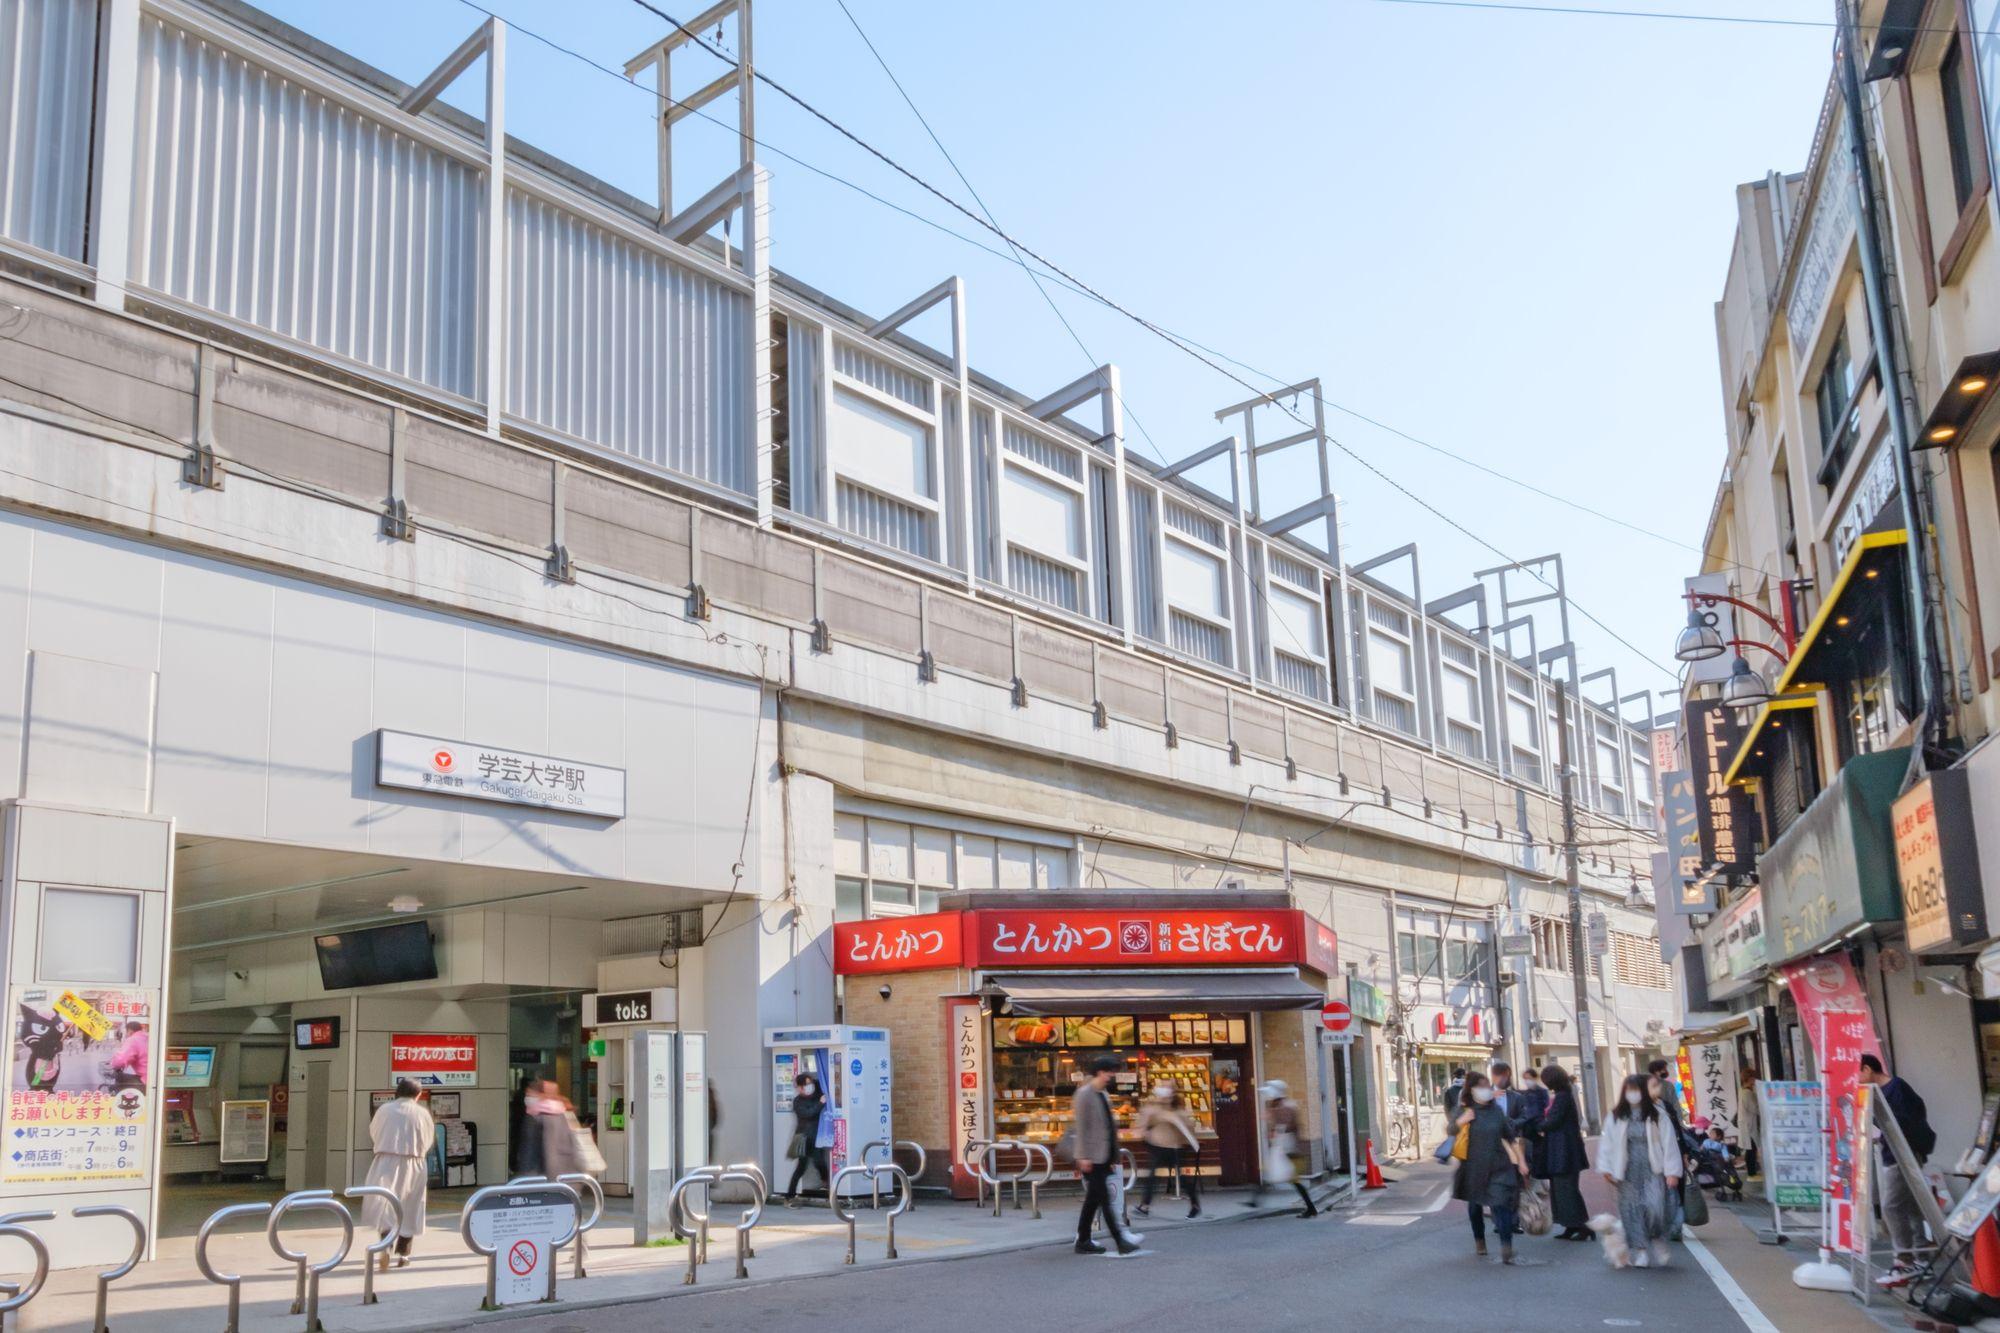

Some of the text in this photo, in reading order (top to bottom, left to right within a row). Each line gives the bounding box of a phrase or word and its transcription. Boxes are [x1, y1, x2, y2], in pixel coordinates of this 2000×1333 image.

[422, 772, 463, 788] 東急電鉄
[478, 753, 585, 792] 学芸大学駅
[480, 781, 564, 803] Gakugei-daigaku
[850, 930, 943, 962] とんかつ
[993, 922, 1112, 953] とんかつ
[1158, 922, 1172, 952] 新宿
[1177, 921, 1283, 953] さぼてん
[615, 1000, 647, 1020] toks
[961, 1015, 975, 1070] とんかつ
